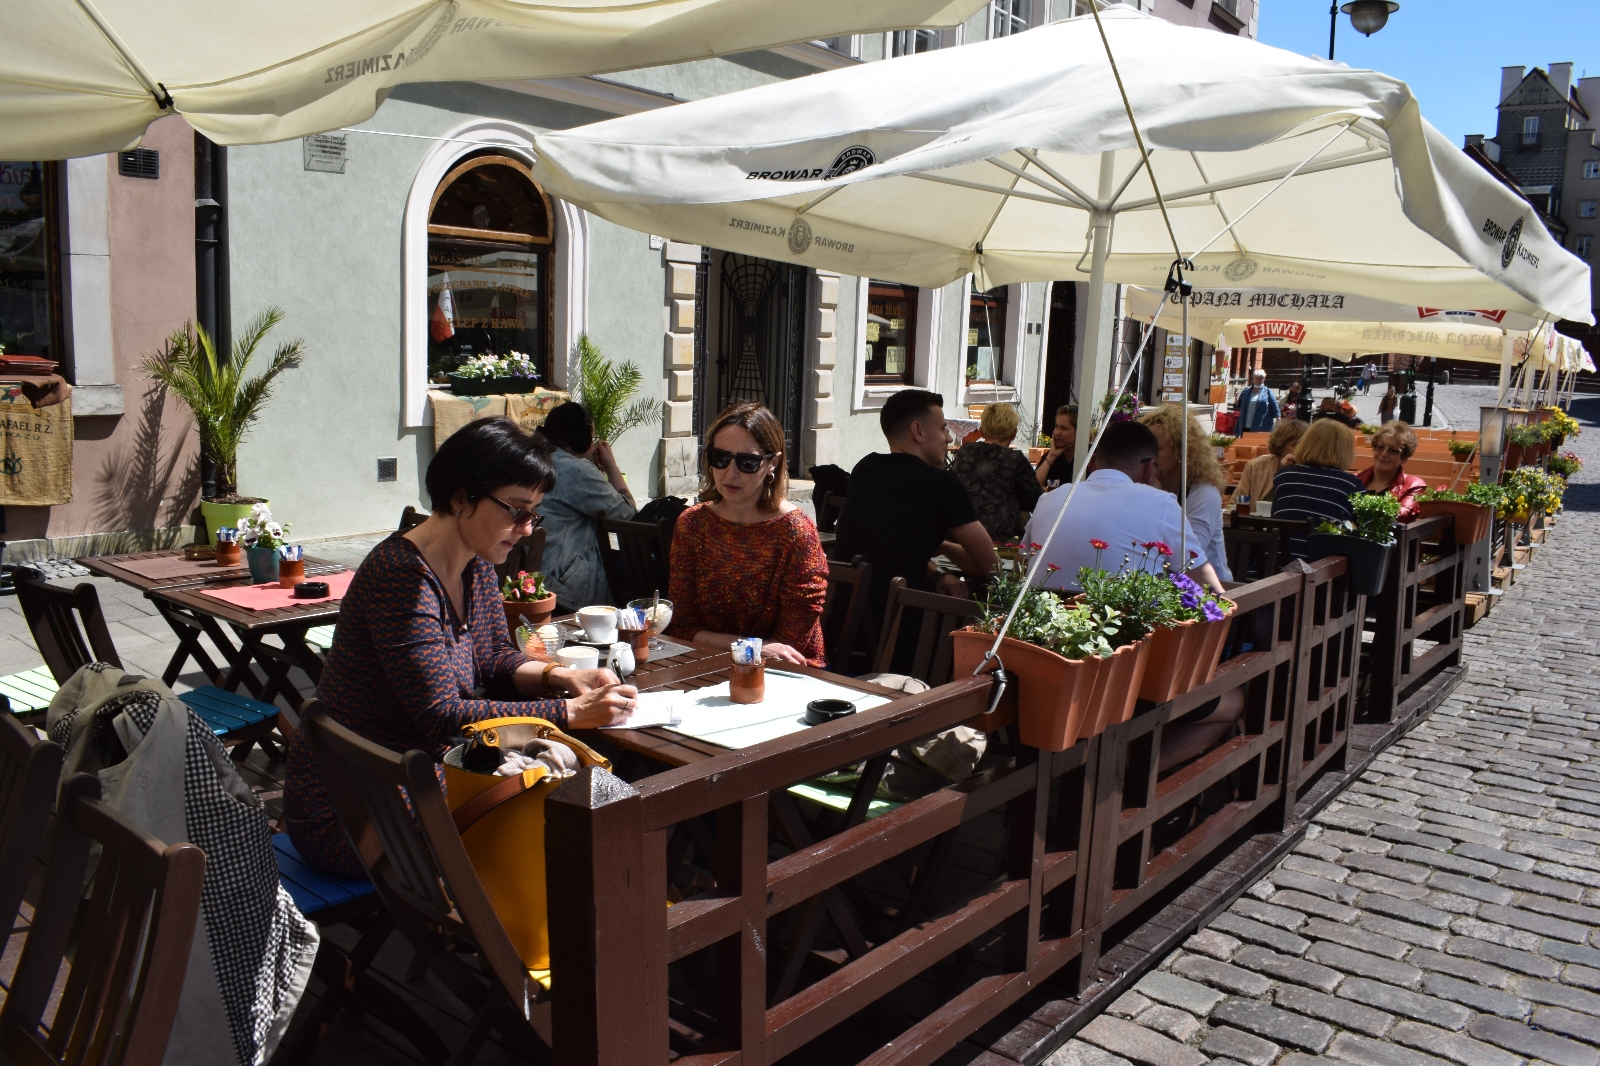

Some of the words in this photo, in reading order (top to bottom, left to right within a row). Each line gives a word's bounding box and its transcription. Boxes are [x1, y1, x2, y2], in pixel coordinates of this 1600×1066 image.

[841, 148, 872, 161] BROWAR
[746, 168, 824, 181] BROWAR
[1482, 218, 1507, 244] BROWAR
[1189, 291, 1243, 308] PANA
[481, 318, 489, 329] Z
